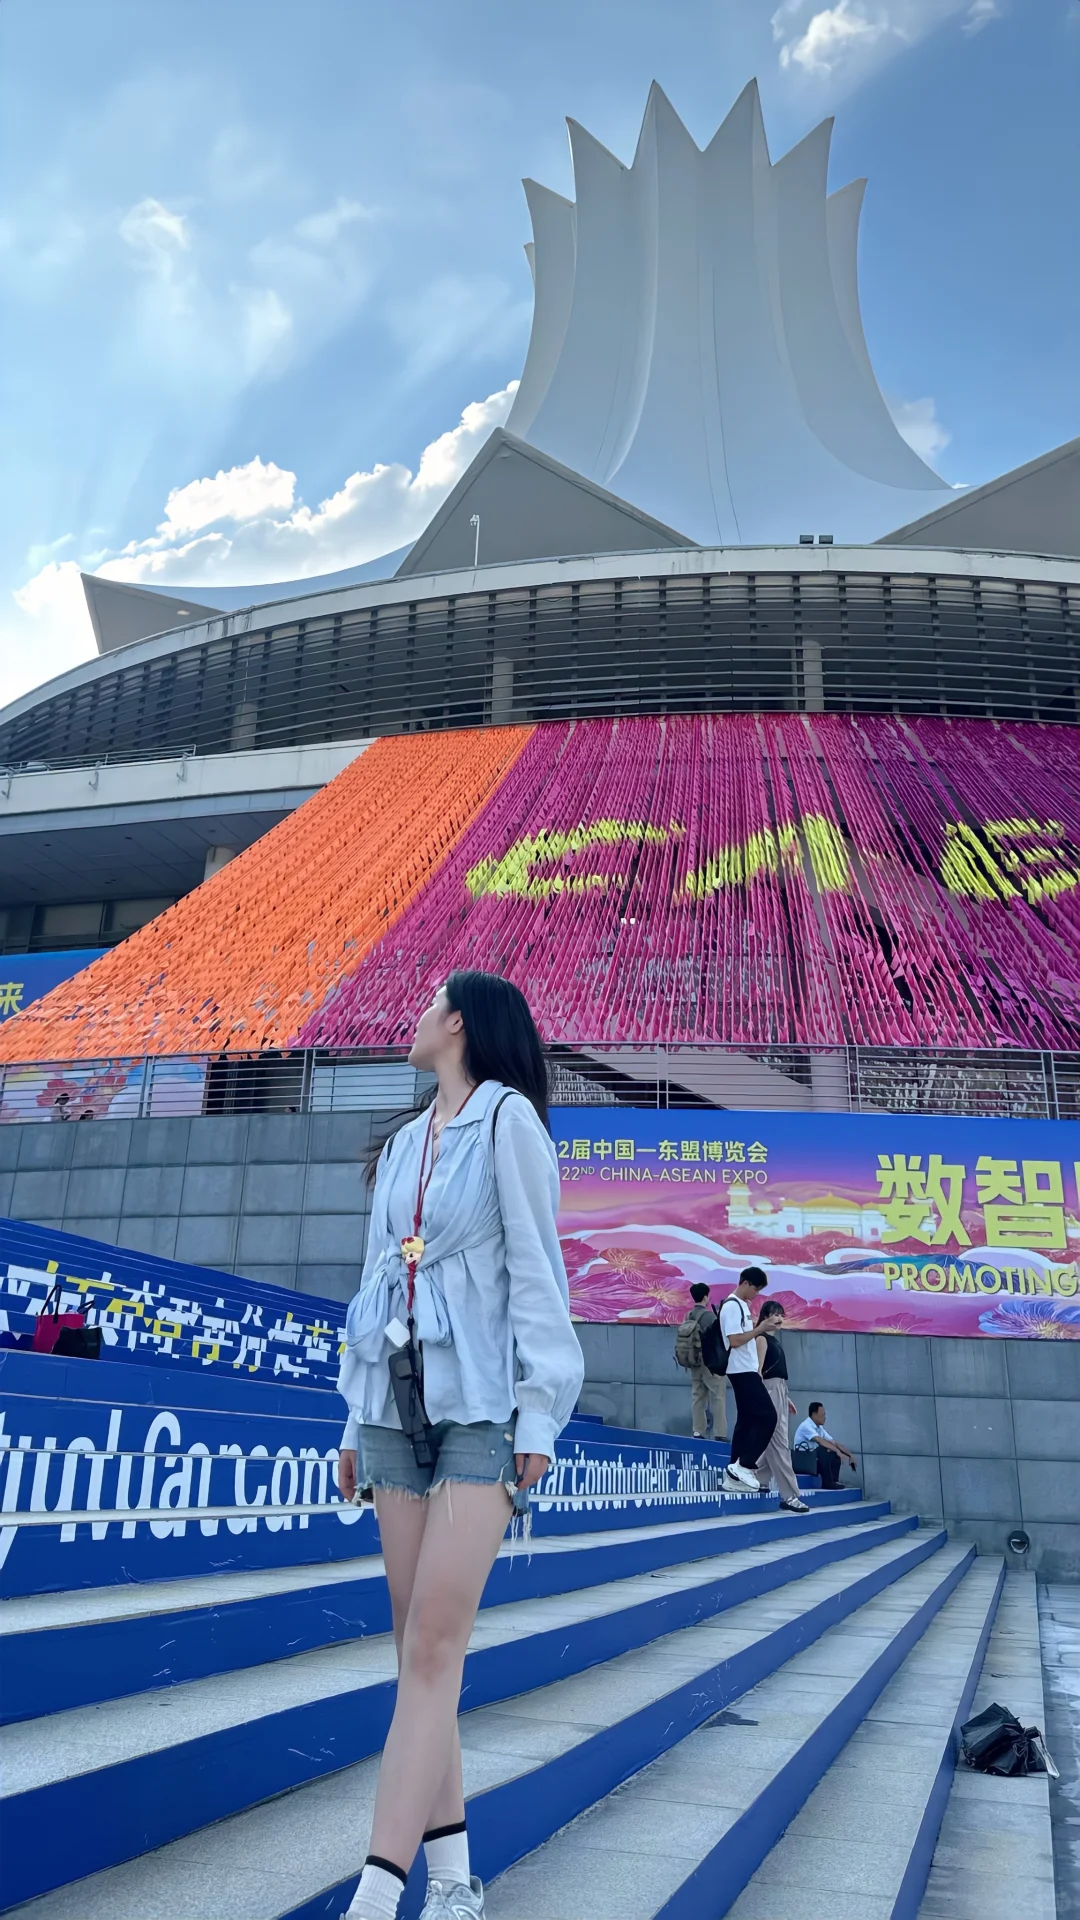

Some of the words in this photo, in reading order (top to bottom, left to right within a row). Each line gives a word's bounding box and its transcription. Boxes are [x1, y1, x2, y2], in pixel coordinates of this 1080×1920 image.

[555, 1139, 768, 1163] 2届中国—东盟博览会
[600, 1167, 716, 1183] CHINA-ASEAN
[722, 1169, 768, 1184] EXPO
[876, 1154, 1080, 1249] 数智
[883, 1262, 1080, 1297] PROMOTING
